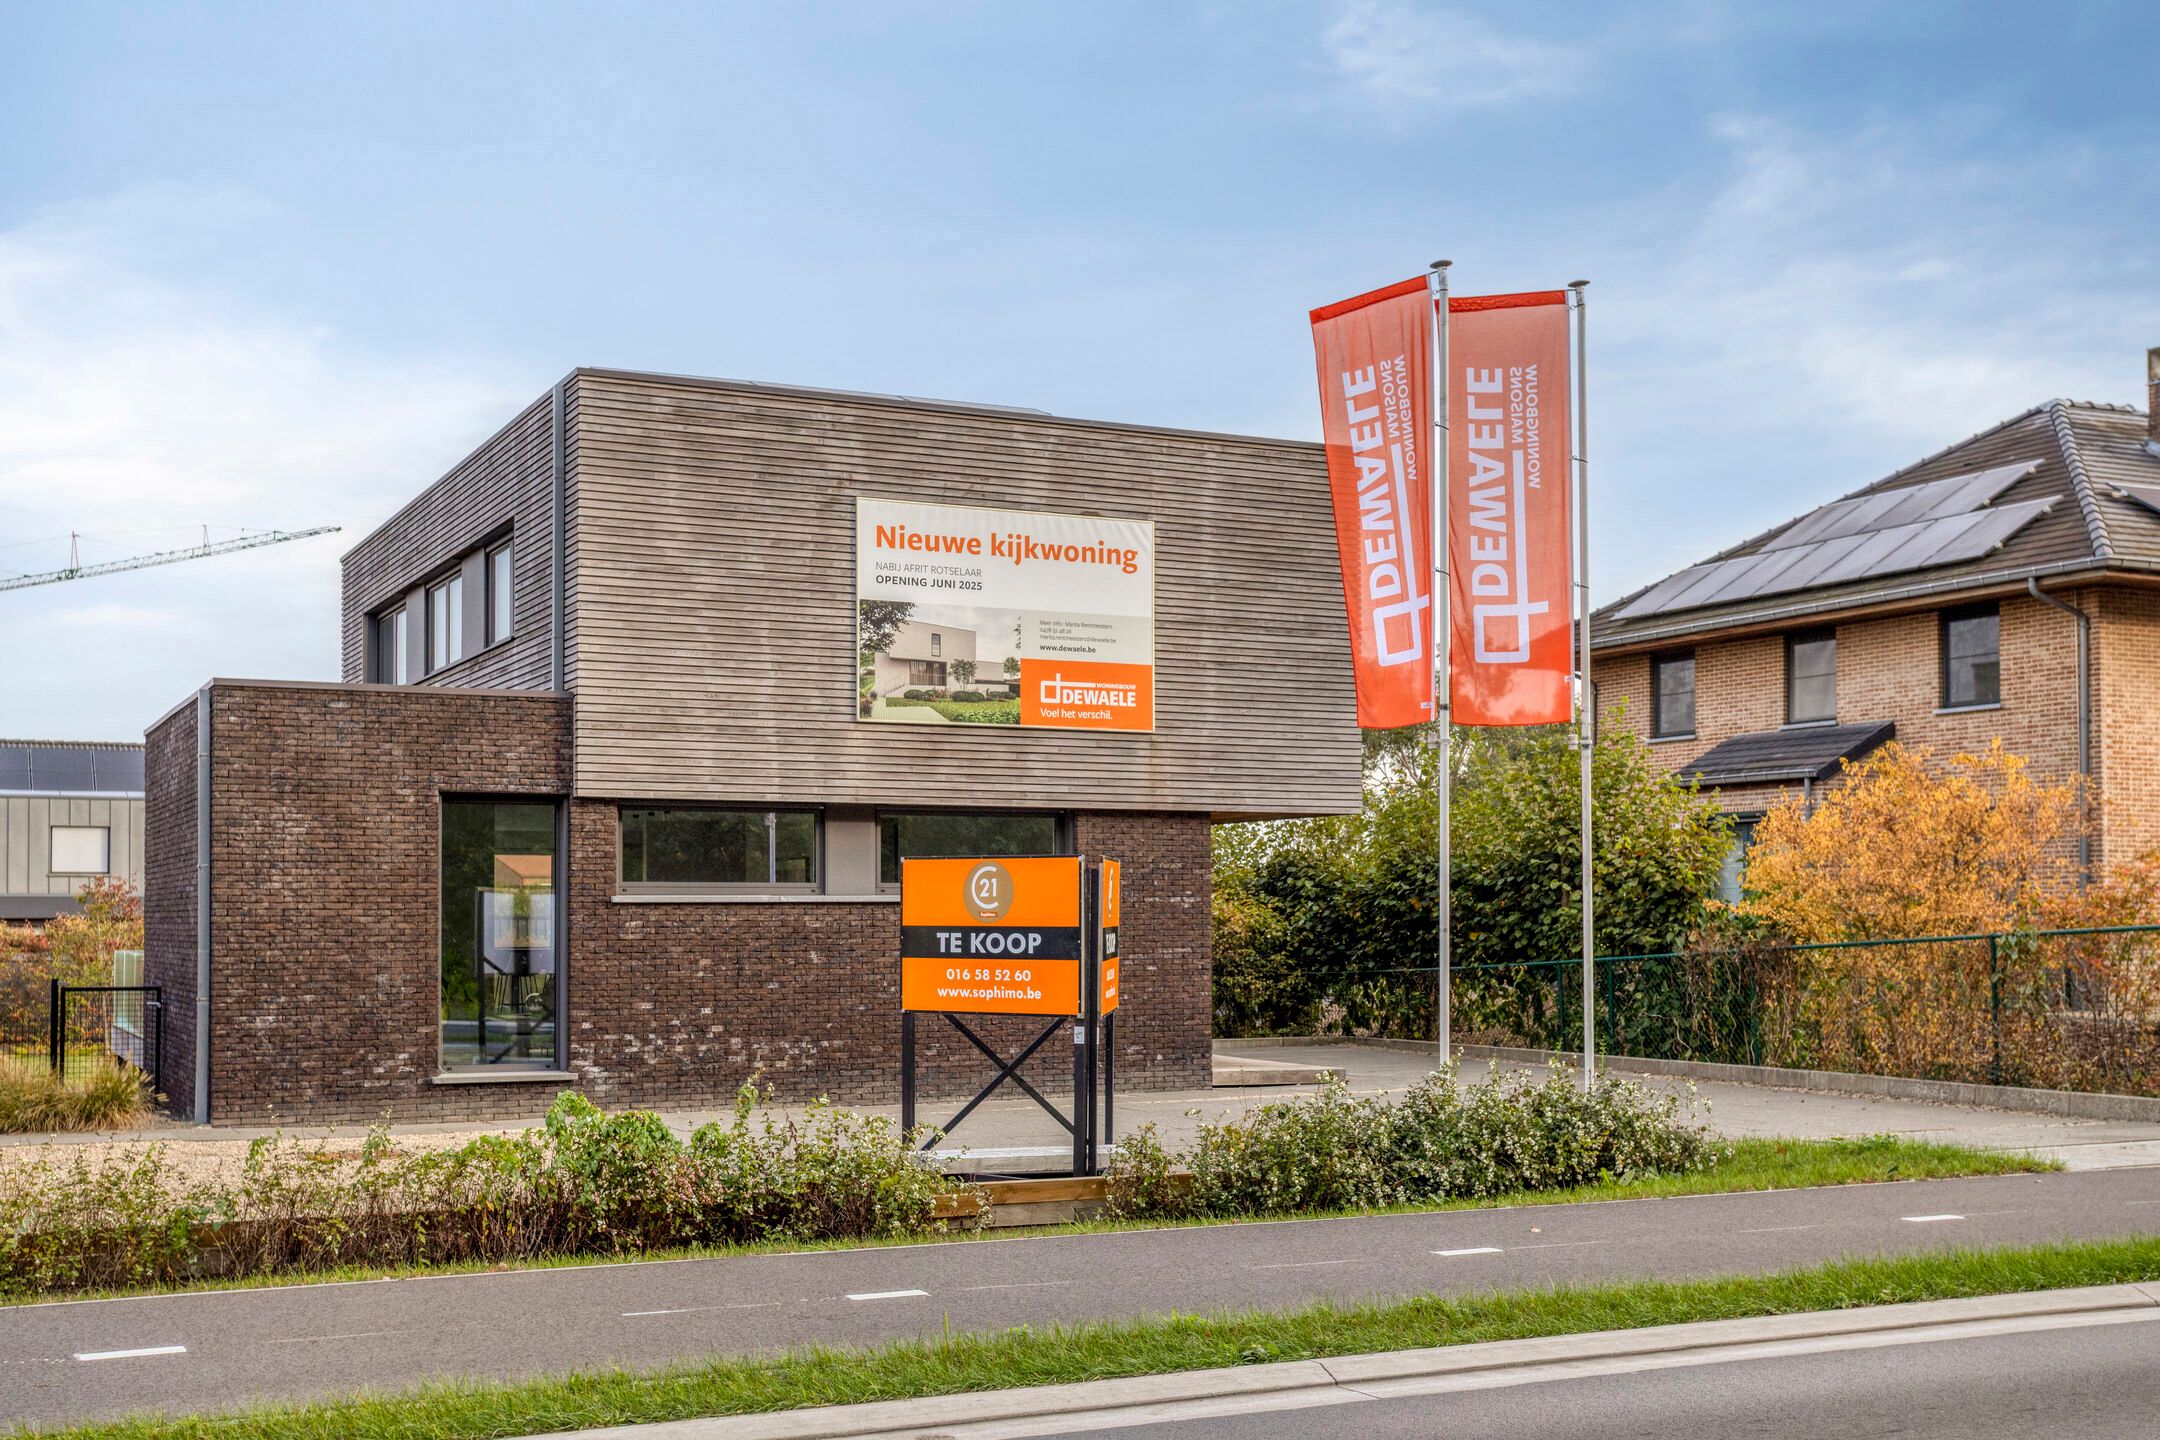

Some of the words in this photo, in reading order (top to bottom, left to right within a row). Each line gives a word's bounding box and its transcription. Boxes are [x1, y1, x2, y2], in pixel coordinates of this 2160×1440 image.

[875, 524, 982, 556] Nieuwe
[990, 532, 1139, 574] kijkwoning
[875, 561, 901, 572] NABIJ
[903, 563, 929, 574] AFRIT
[930, 565, 982, 577] ROTSELAAR
[875, 574, 928, 587] OPENING
[930, 577, 956, 589] JUNI
[958, 580, 983, 591] 2025
[1040, 644, 1096, 653] www.dewaele.be
[1062, 689, 1136, 707] DEWAELE
[1040, 708, 1060, 718] Voel
[1061, 708, 1076, 718] het
[1078, 709, 1113, 720] verschil.
[936, 932, 962, 953] TE
[970, 932, 1042, 954] KOOP
[946, 968, 971, 981] 016
[974, 968, 990, 981] 58
[994, 969, 1011, 982] 52
[1014, 969, 1031, 982] 60
[937, 986, 1042, 1001] www.sophimo.be
